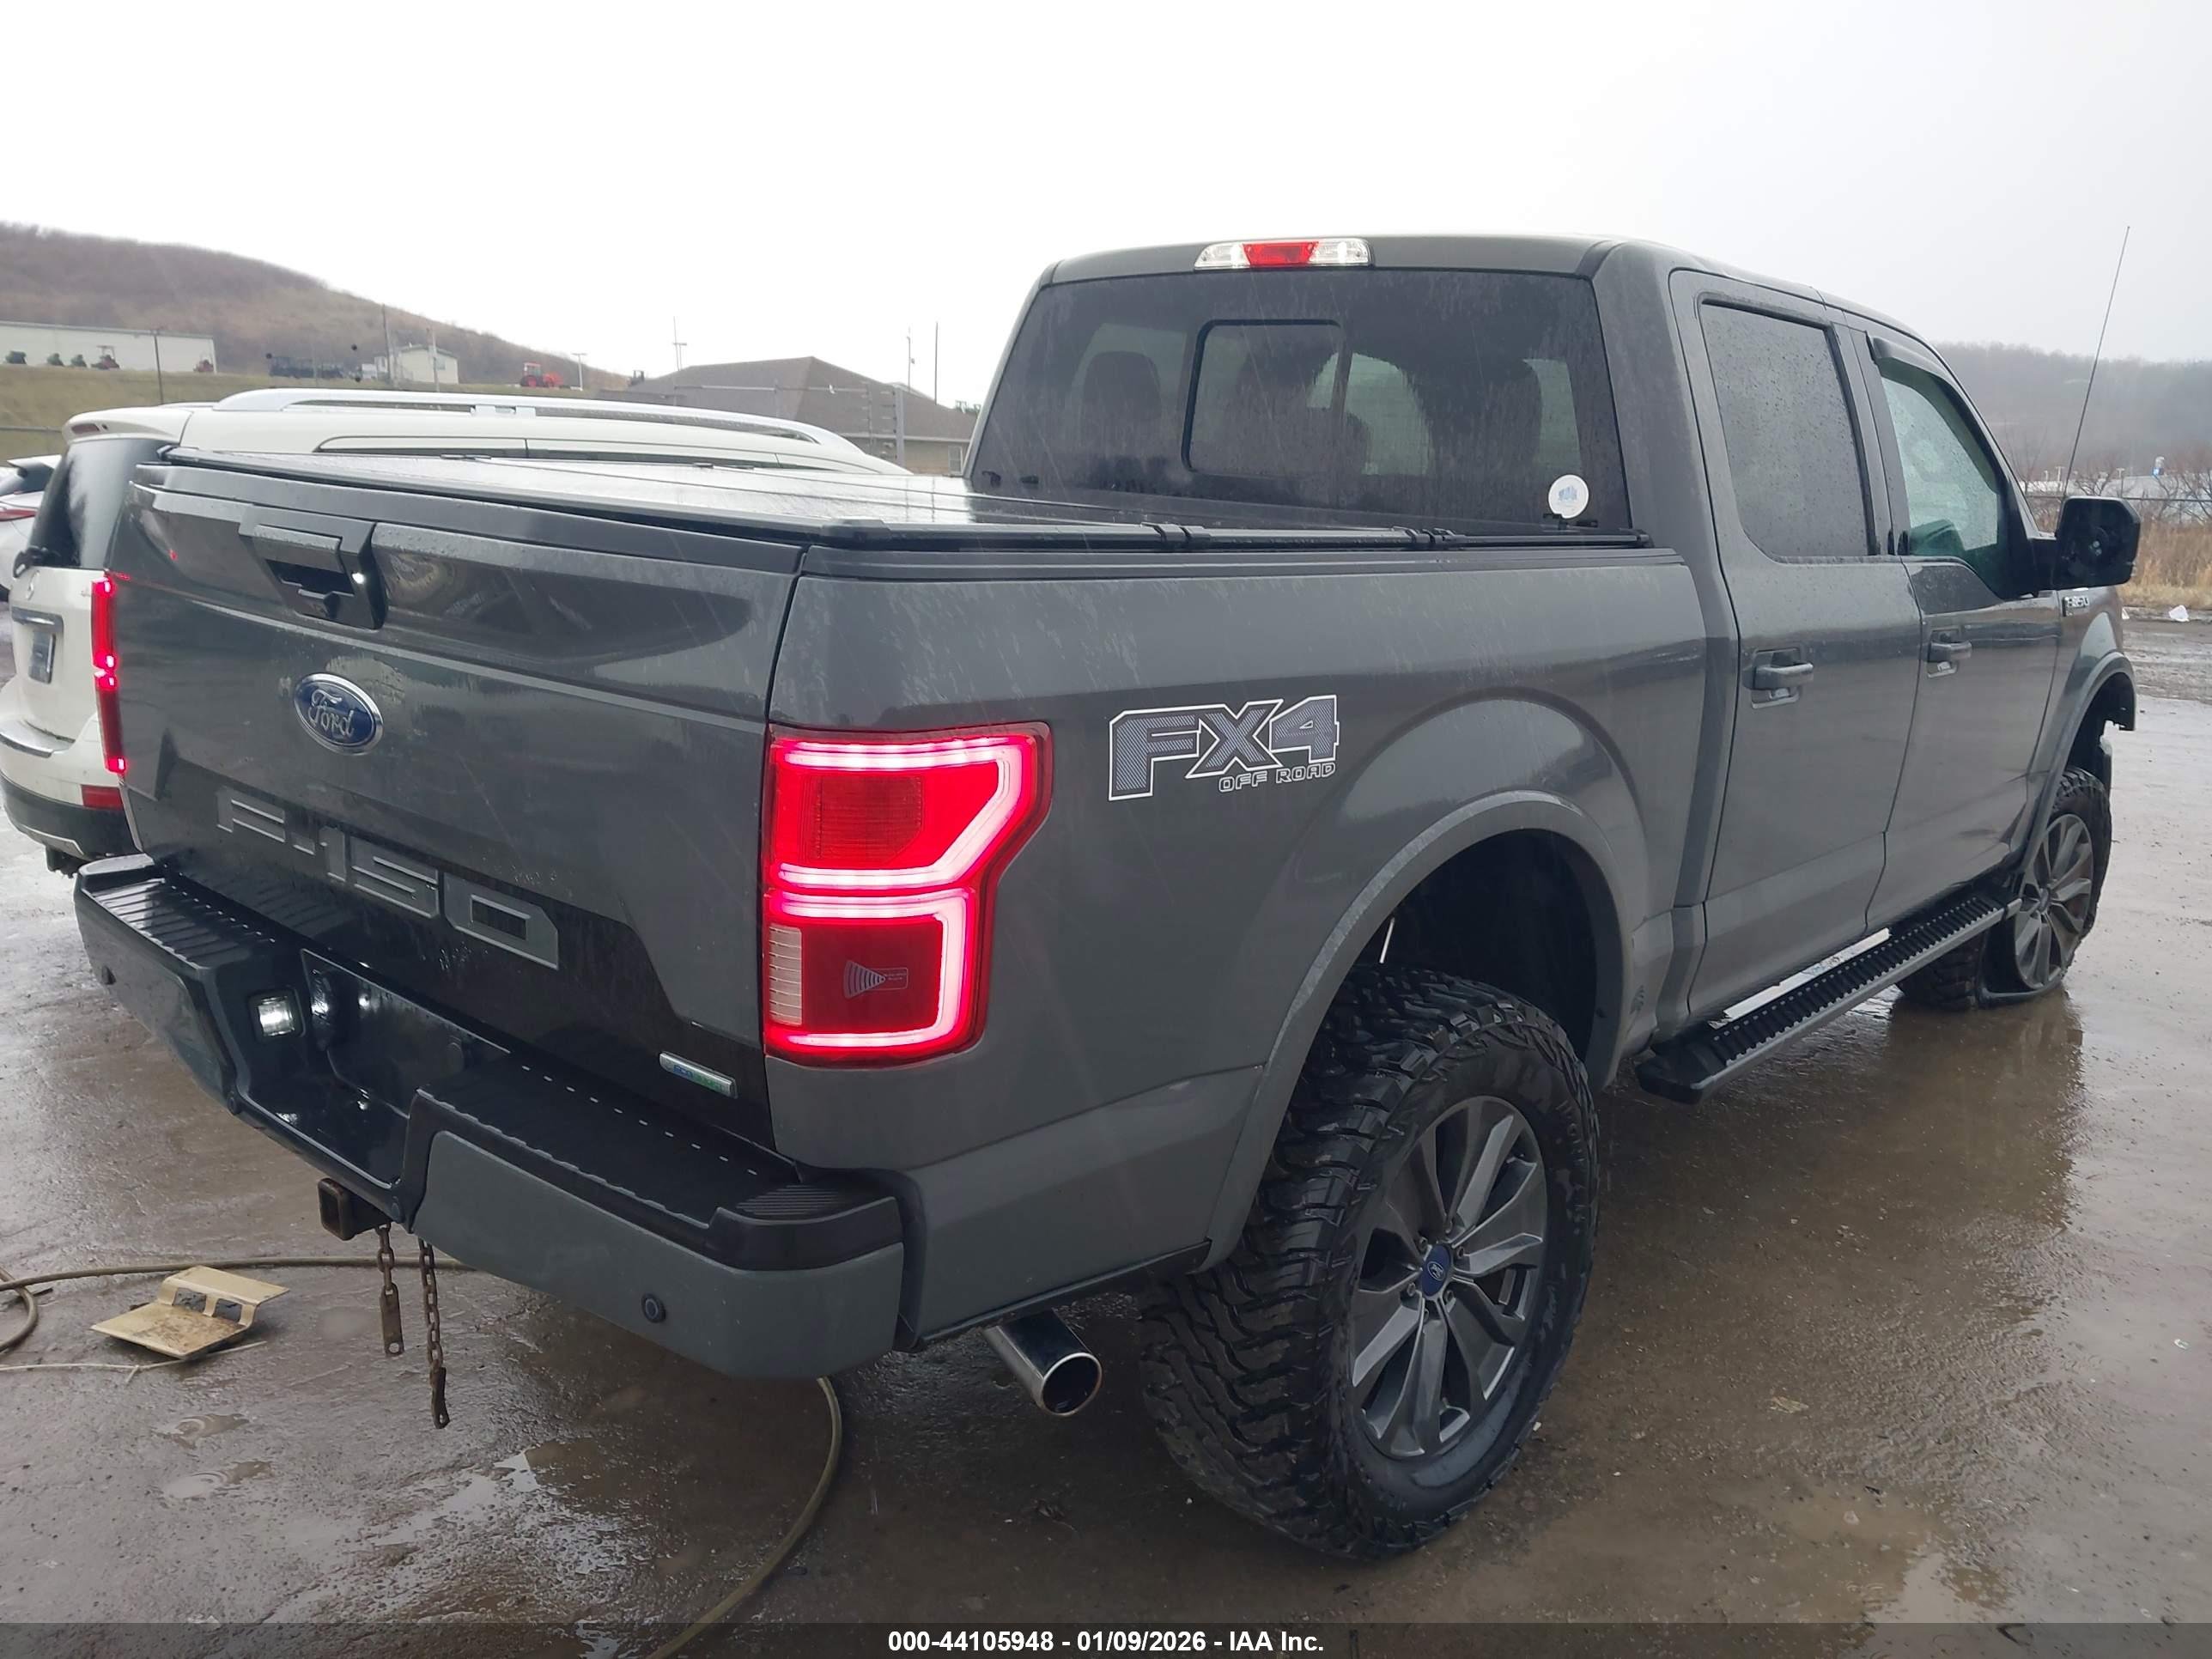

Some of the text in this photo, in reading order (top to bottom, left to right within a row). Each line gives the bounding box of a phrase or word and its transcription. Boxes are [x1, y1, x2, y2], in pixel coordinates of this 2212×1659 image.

[307, 689, 355, 738] Ford
[1109, 694, 1340, 801] FX4
[1218, 762, 1336, 793] OFF ROAD
[216, 785, 559, 970] F-150
